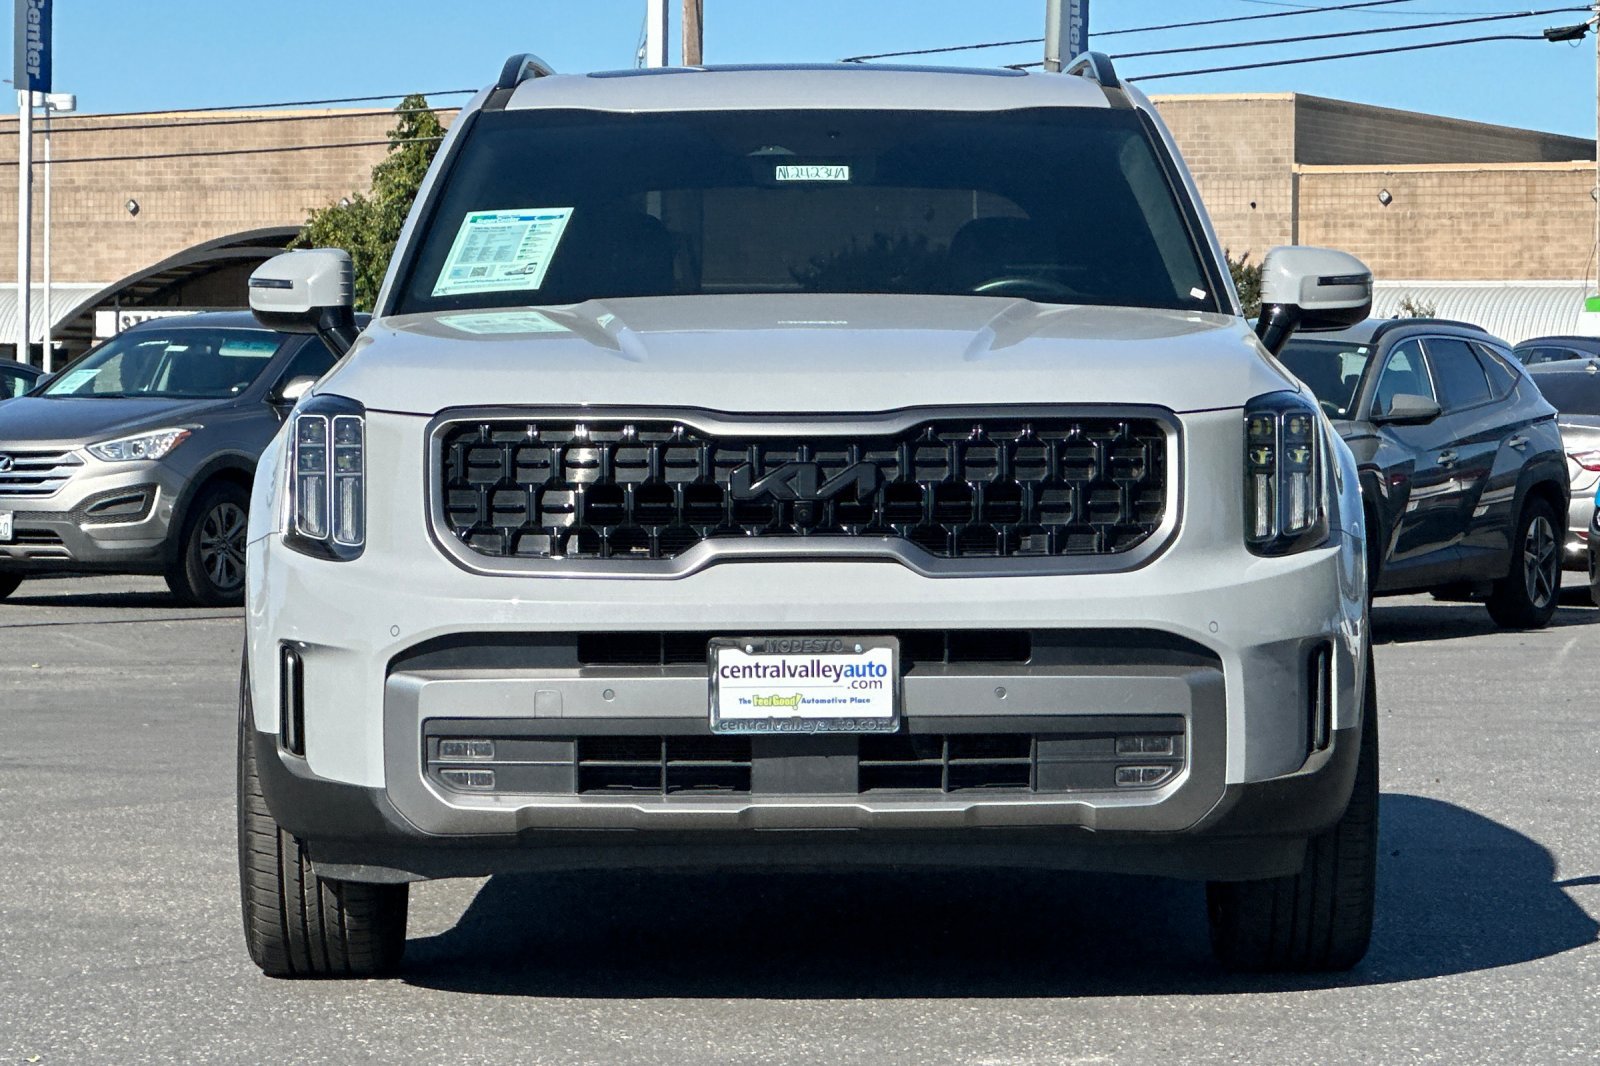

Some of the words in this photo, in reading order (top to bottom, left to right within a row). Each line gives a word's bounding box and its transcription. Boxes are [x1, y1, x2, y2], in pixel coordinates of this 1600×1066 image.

[729, 461, 877, 500] KIA
[764, 639, 843, 653] MODESTO
[720, 659, 887, 683] centralvalleyauto
[847, 679, 883, 690] .com
[739, 697, 752, 705] The
[801, 696, 847, 704] Automotive
[849, 696, 871, 704] Place
[720, 716, 890, 734] centralvalleyauto.com
